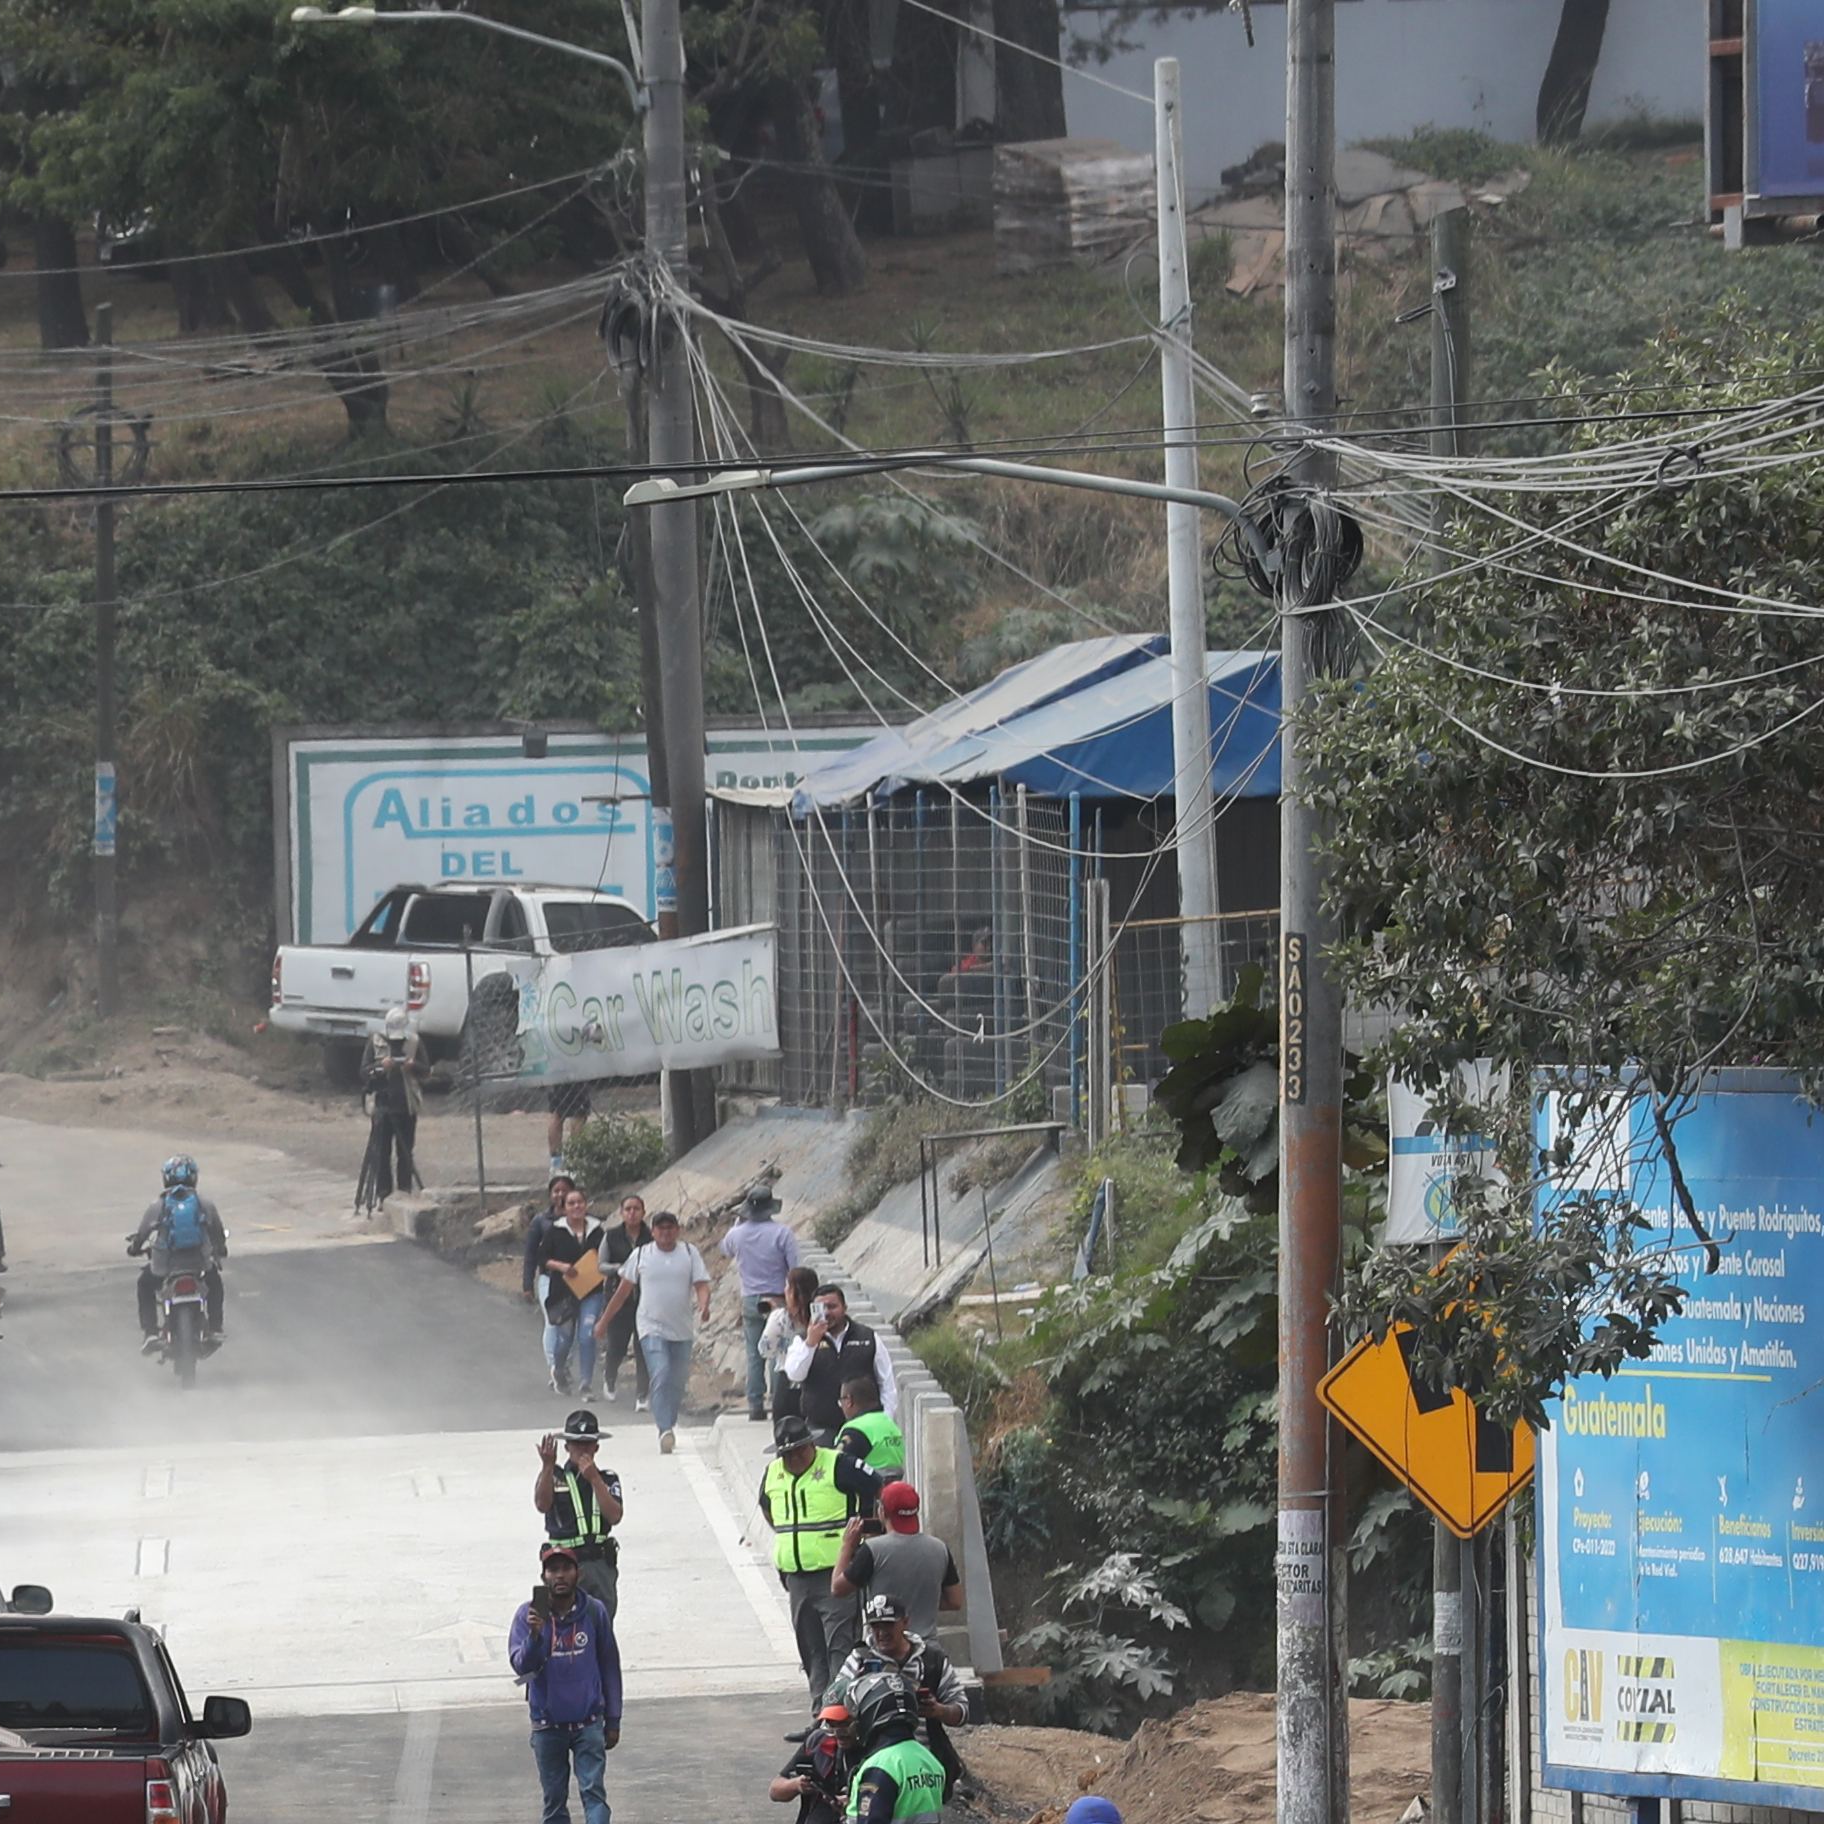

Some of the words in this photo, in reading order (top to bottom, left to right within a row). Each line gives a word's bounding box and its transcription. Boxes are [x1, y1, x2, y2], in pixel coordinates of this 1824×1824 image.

[372, 788, 622, 832] Aliados
[442, 851, 523, 877] DEL
[548, 981, 625, 1056] Car
[633, 958, 772, 1046] Wash
[1708, 1209, 1716, 1237] y
[1719, 1204, 1756, 1233] Puente
[1758, 1204, 1824, 1241] Rodriguitos,
[1745, 1249, 1786, 1278] Corosal
[1679, 1292, 1742, 1321] Guatemala
[1743, 1303, 1751, 1329] y
[1754, 1295, 1805, 1324] Naciones
[1686, 1337, 1727, 1364] Unidas
[1729, 1346, 1738, 1373] y
[1563, 1383, 1667, 1439] Guatemala
[1718, 1513, 1772, 1538] Beneficiarios
